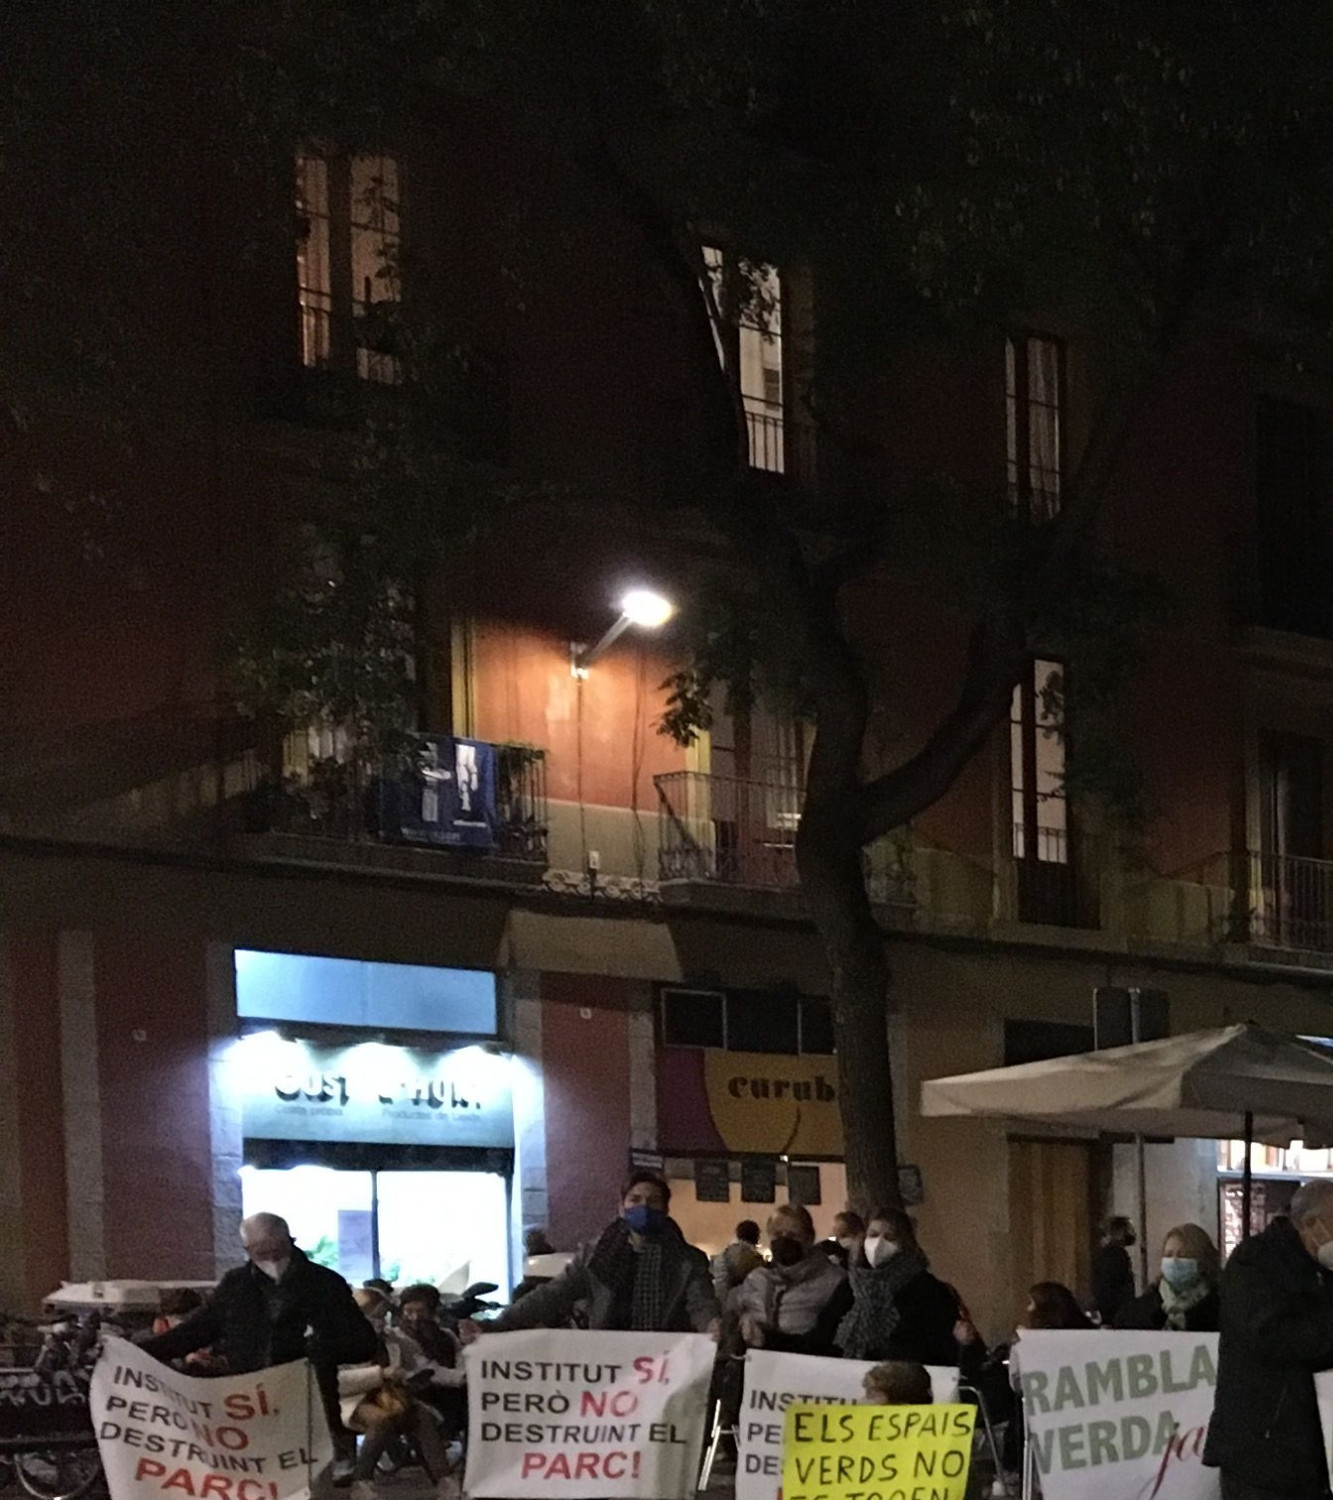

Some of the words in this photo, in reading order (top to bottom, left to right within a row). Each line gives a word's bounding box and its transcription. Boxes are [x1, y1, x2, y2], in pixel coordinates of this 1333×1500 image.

[481, 1359, 622, 1384] INSTITUT
[1021, 1344, 1216, 1416] RAMBLA
[481, 1390, 570, 1414] PERÒ
[579, 1390, 638, 1418] NO
[481, 1421, 641, 1444] DESTRUINT
[649, 1423, 687, 1445] EL
[794, 1411, 855, 1443] ELS
[867, 1410, 972, 1442] ESPAIS
[1029, 1409, 1180, 1475] VERDA
[278, 1447, 318, 1470] EL
[521, 1450, 642, 1480] PARC!
[795, 1453, 898, 1486] VERDS
[913, 1449, 966, 1479] NO
